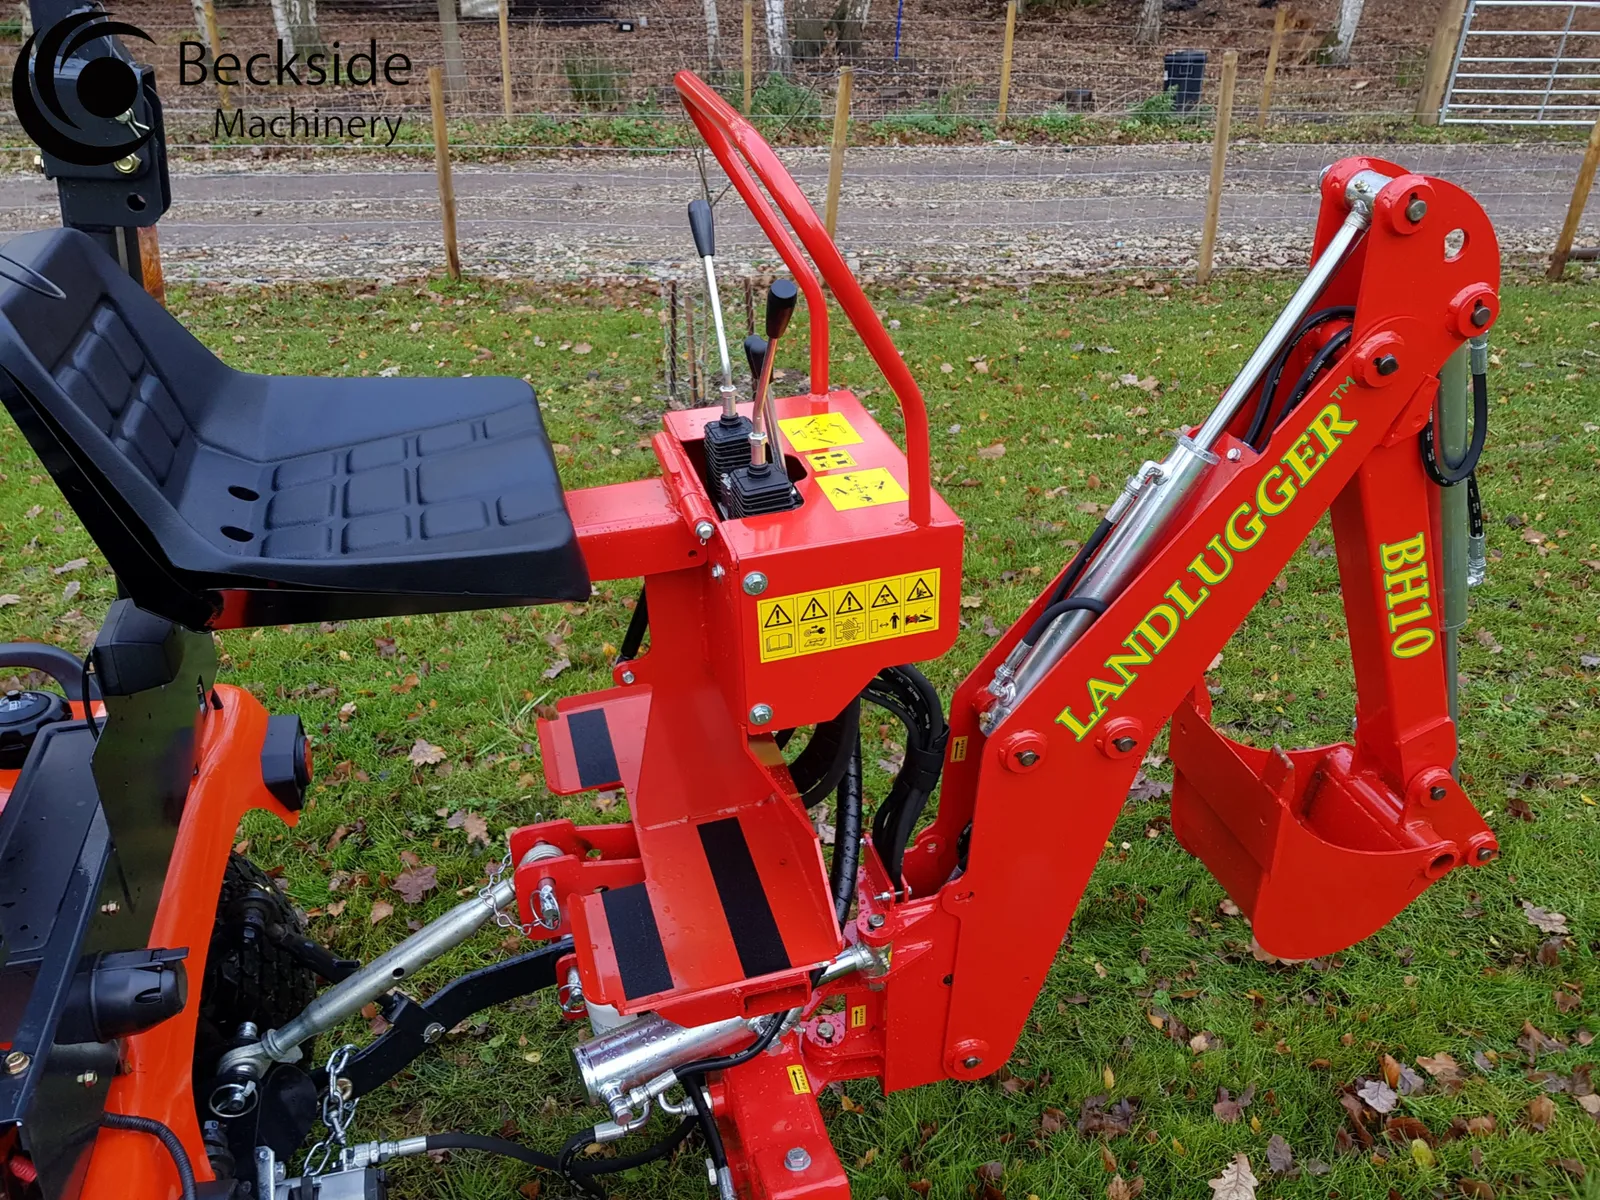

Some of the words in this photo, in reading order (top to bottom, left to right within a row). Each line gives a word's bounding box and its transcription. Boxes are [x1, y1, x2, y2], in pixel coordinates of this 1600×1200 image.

[1055, 403, 1359, 742] LANDLUGGER
[1379, 531, 1435, 660] BH10
[796, 1068, 808, 1090] GREASE
